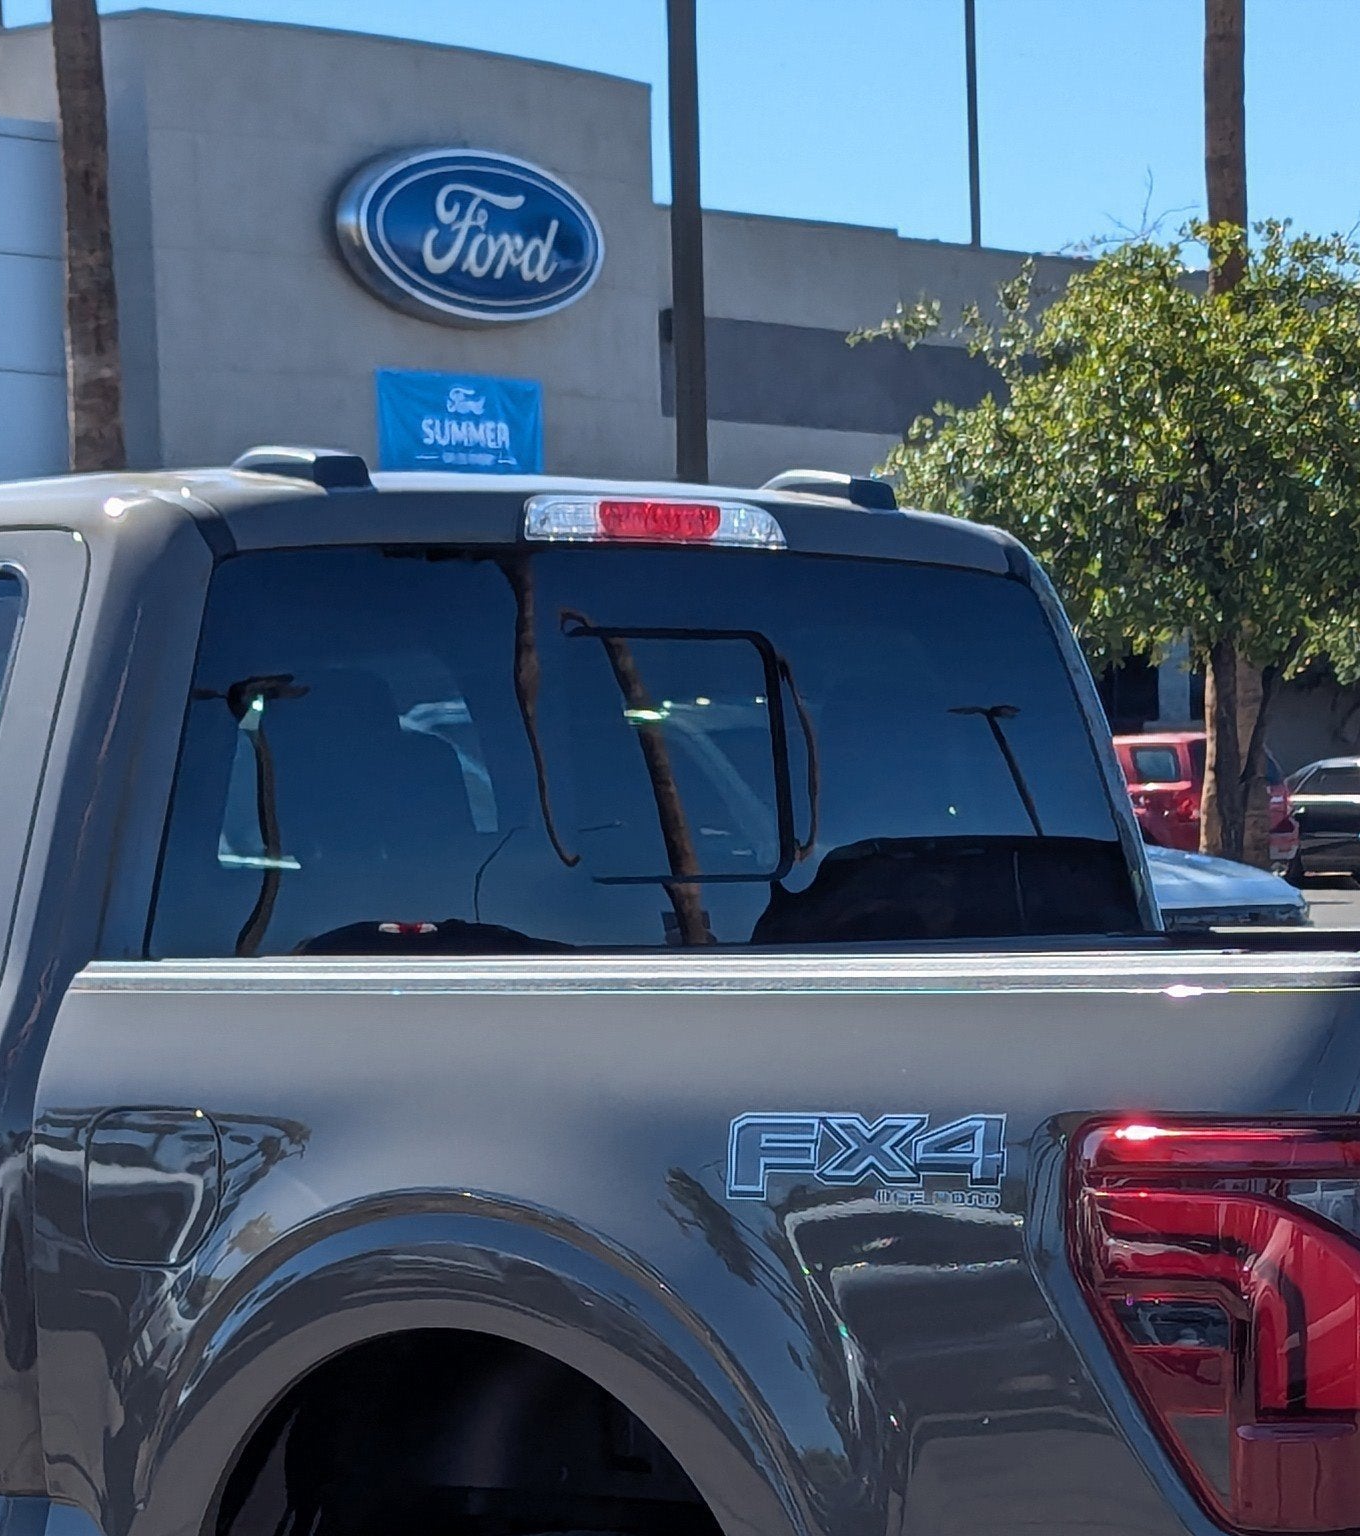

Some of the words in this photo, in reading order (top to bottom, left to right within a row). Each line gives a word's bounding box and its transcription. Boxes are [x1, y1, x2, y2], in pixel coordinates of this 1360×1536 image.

[423, 183, 559, 283] Ford
[421, 417, 510, 449] SUMMER
[726, 1111, 1007, 1200] FX4
